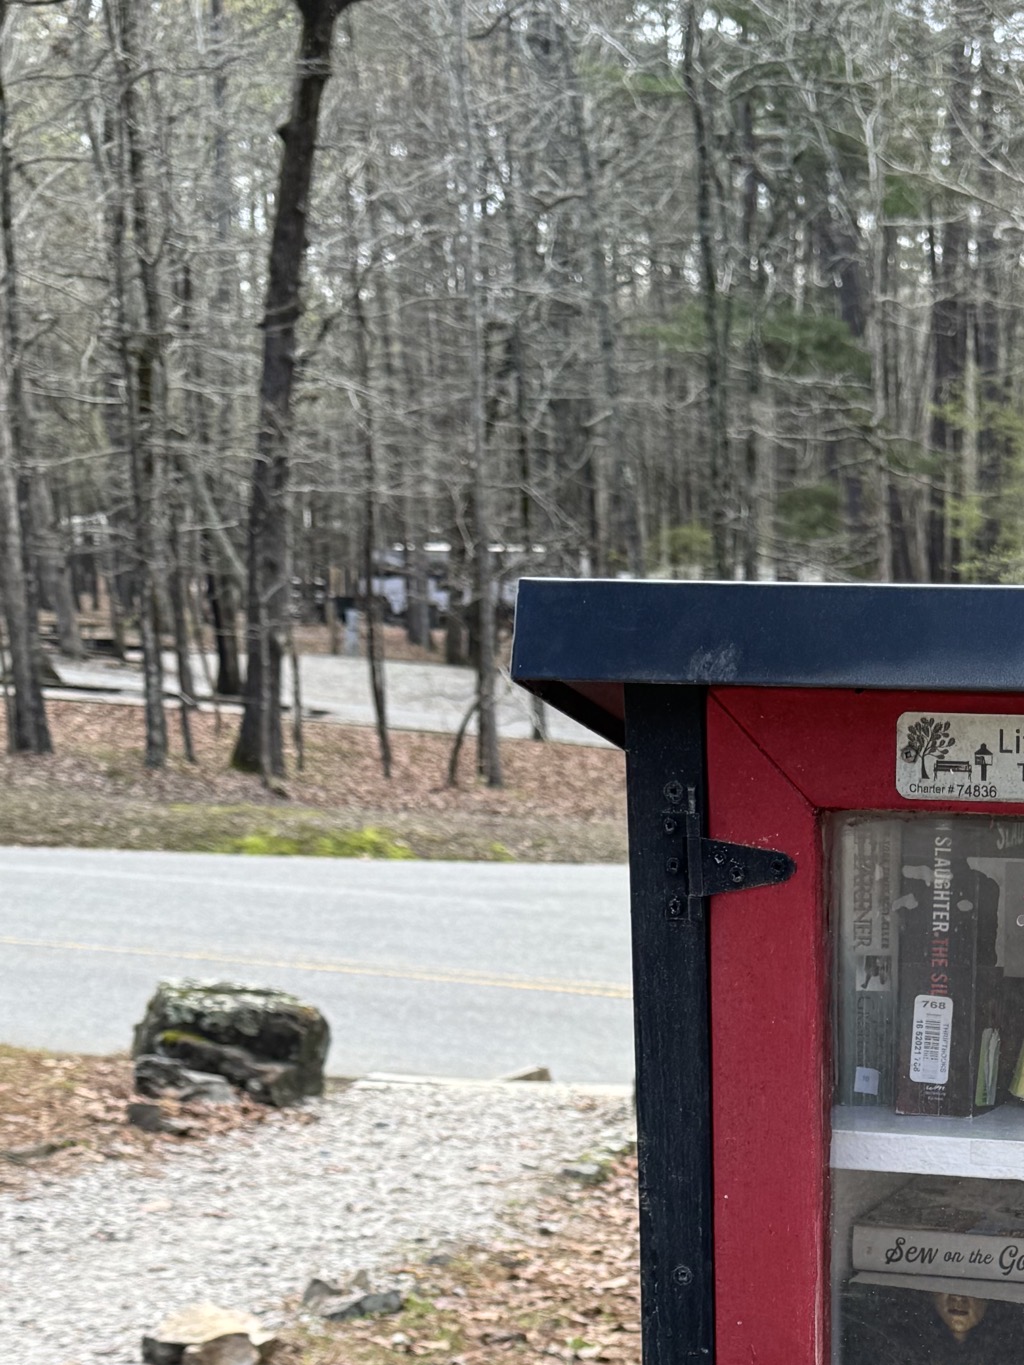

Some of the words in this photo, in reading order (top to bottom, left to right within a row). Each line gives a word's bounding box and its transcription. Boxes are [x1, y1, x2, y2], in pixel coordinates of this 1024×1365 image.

[909, 783, 945, 794] Charter
[956, 784, 997, 798] 74836
[930, 937, 949, 968] THE
[921, 1000, 946, 1010] 768
[884, 1236, 939, 1265] Sew
[943, 1251, 964, 1264] on
[968, 1248, 994, 1266] the
